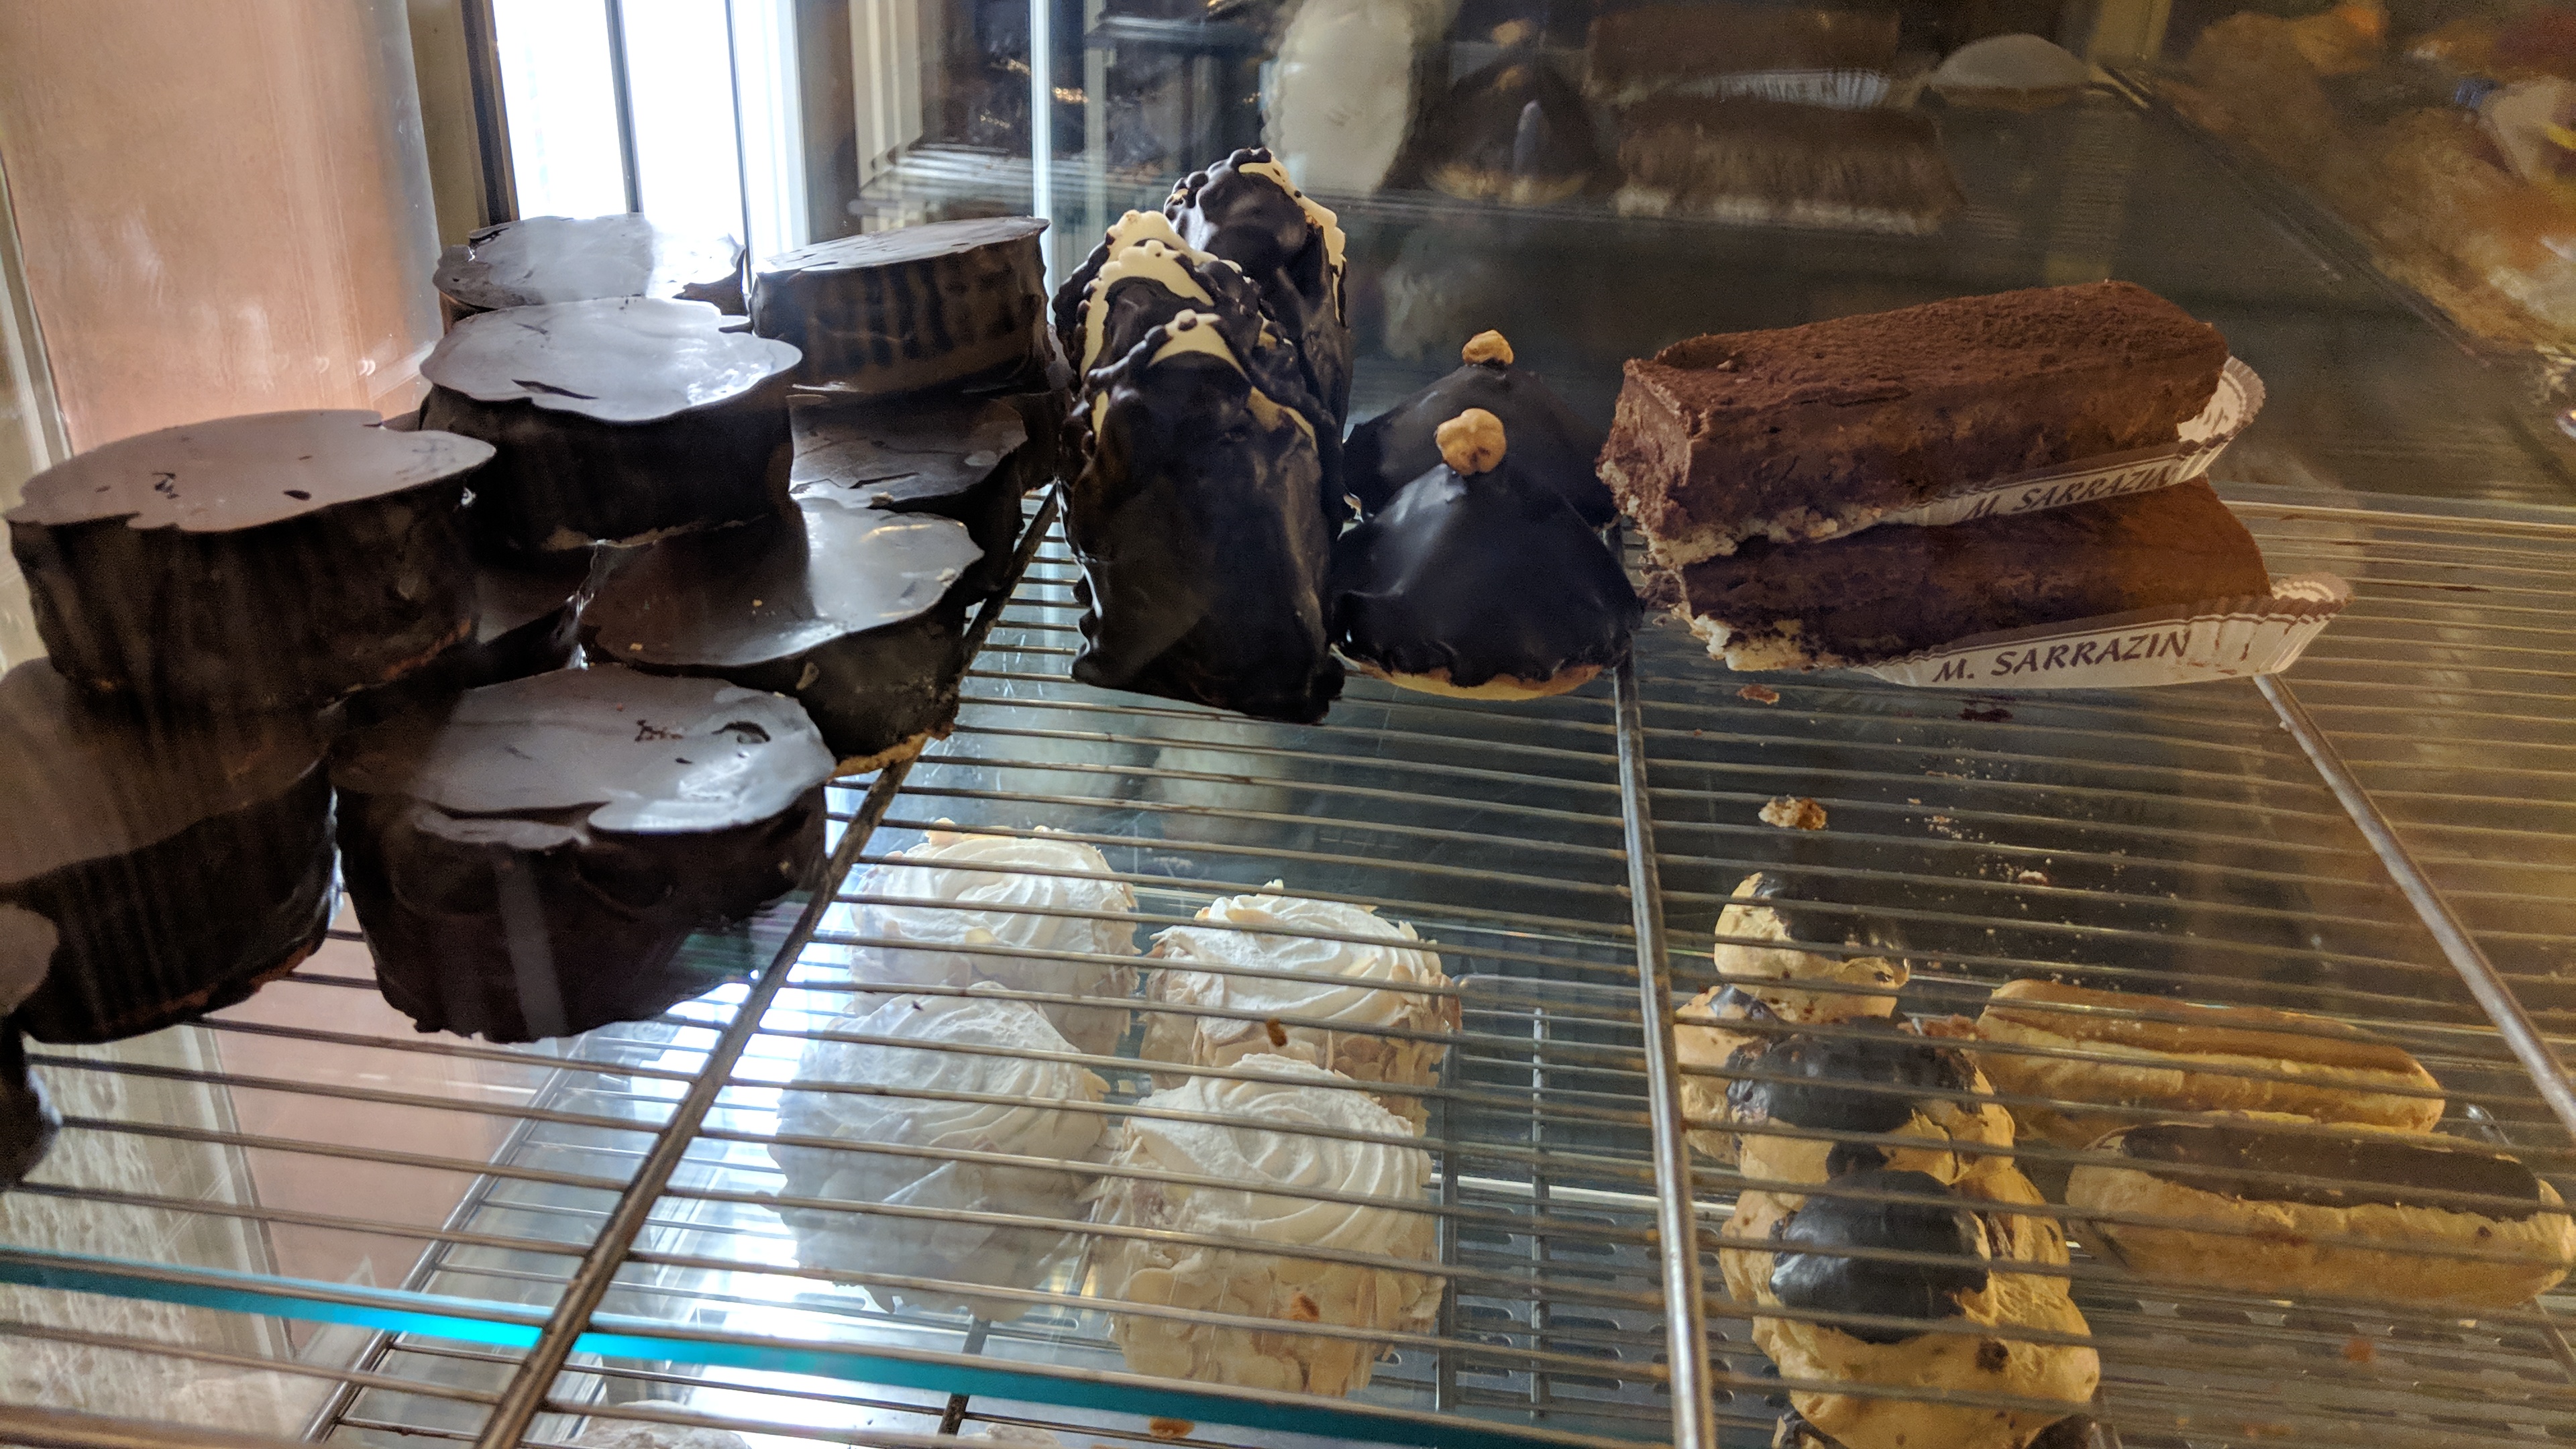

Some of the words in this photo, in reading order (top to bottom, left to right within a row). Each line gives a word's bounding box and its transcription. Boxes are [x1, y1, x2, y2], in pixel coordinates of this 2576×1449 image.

[1962, 494, 2000, 521] M
[2012, 466, 2178, 512] SARRAZIN
[1932, 657, 1974, 683] M.
[1990, 630, 2192, 676] SARRAZIN
